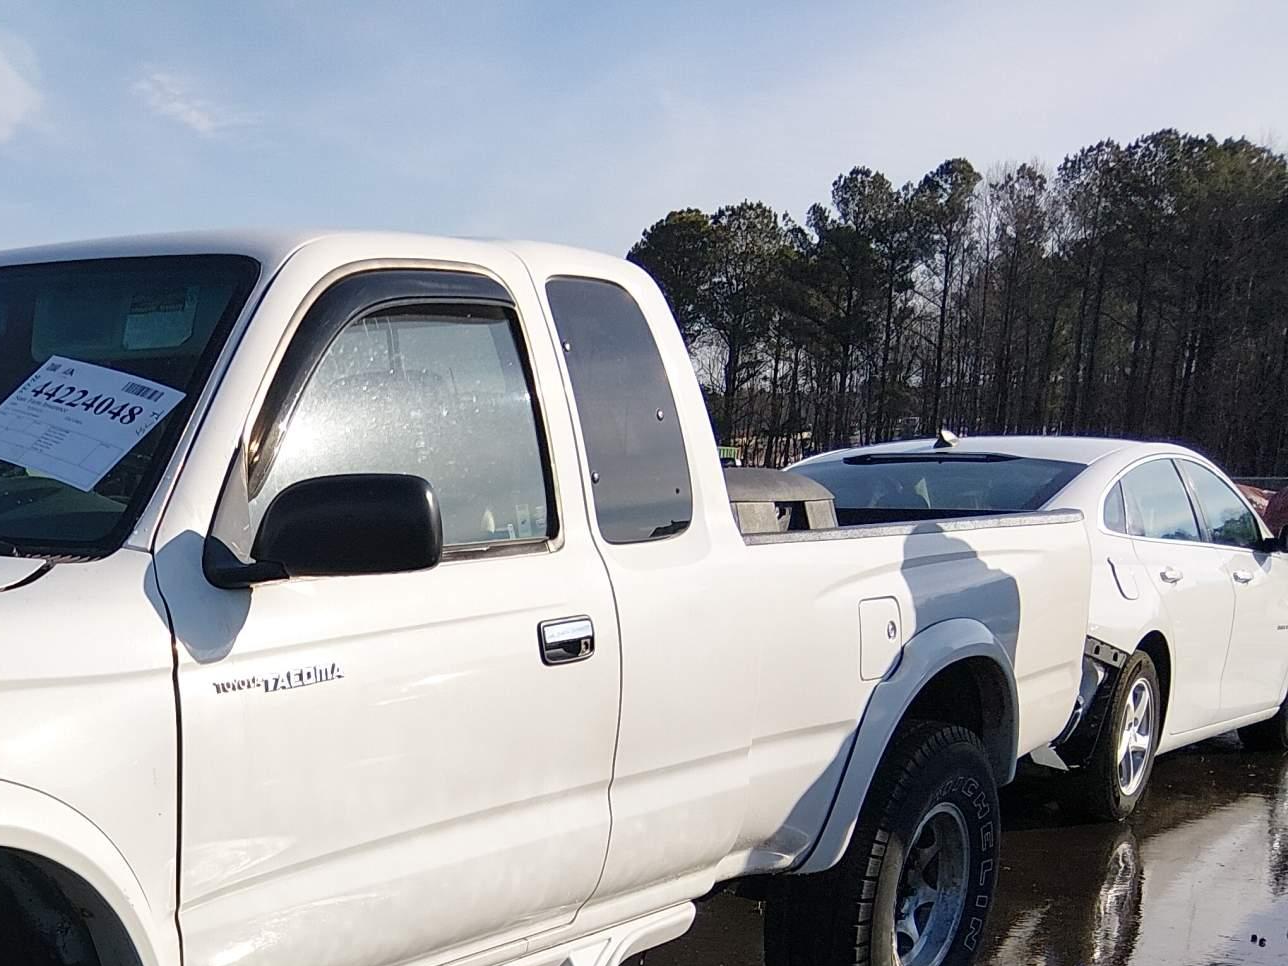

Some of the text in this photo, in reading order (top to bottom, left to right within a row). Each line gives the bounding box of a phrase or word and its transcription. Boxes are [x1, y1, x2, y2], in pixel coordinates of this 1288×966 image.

[31, 381, 144, 425] 44224048
[212, 662, 345, 695] TOYOTA TACOMA
